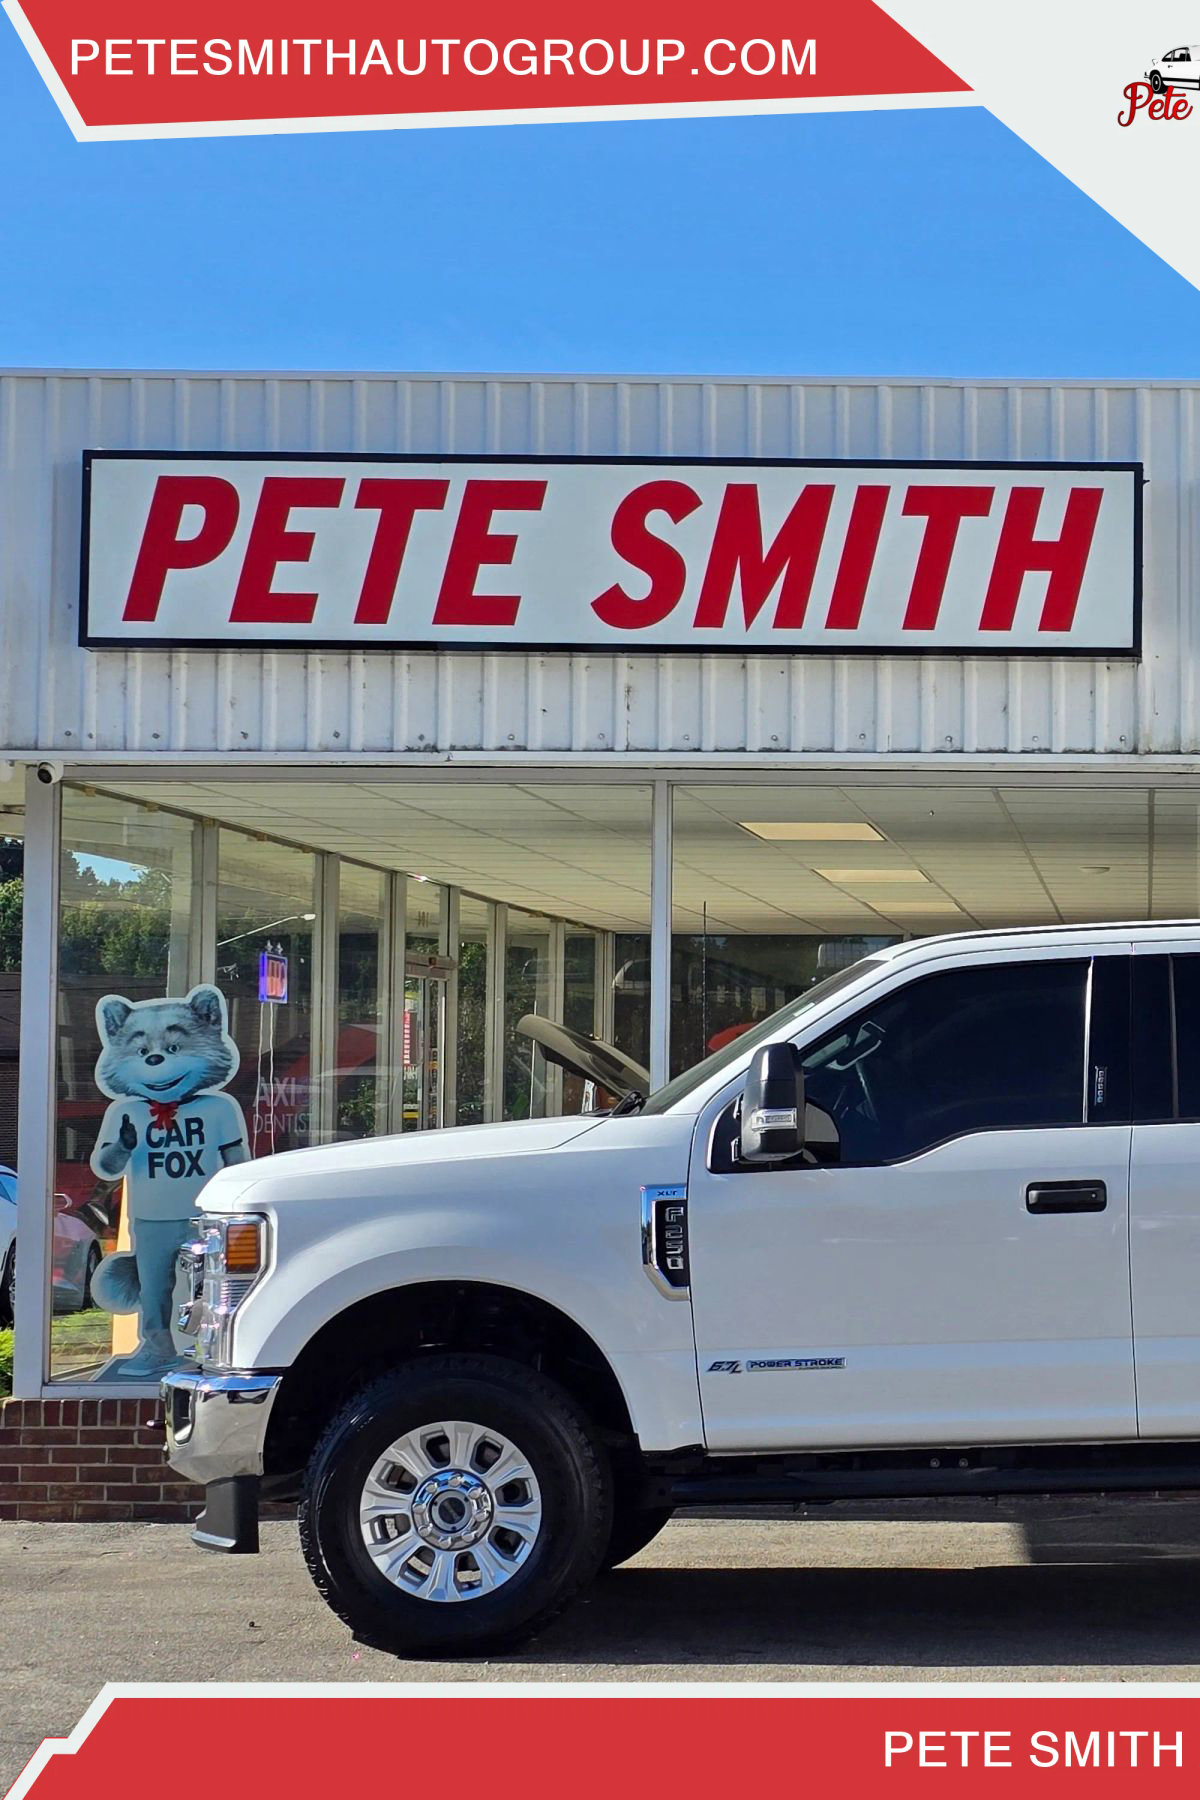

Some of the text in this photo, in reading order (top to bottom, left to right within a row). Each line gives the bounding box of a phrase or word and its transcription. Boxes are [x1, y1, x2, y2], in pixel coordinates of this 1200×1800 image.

[122, 475, 1106, 633] PETE SMITH
[146, 1117, 205, 1149] CAR
[148, 1149, 206, 1179] FOX
[707, 1360, 743, 1374] 6.7L
[750, 1359, 792, 1369] POWER
[795, 1357, 844, 1368] STROKE
